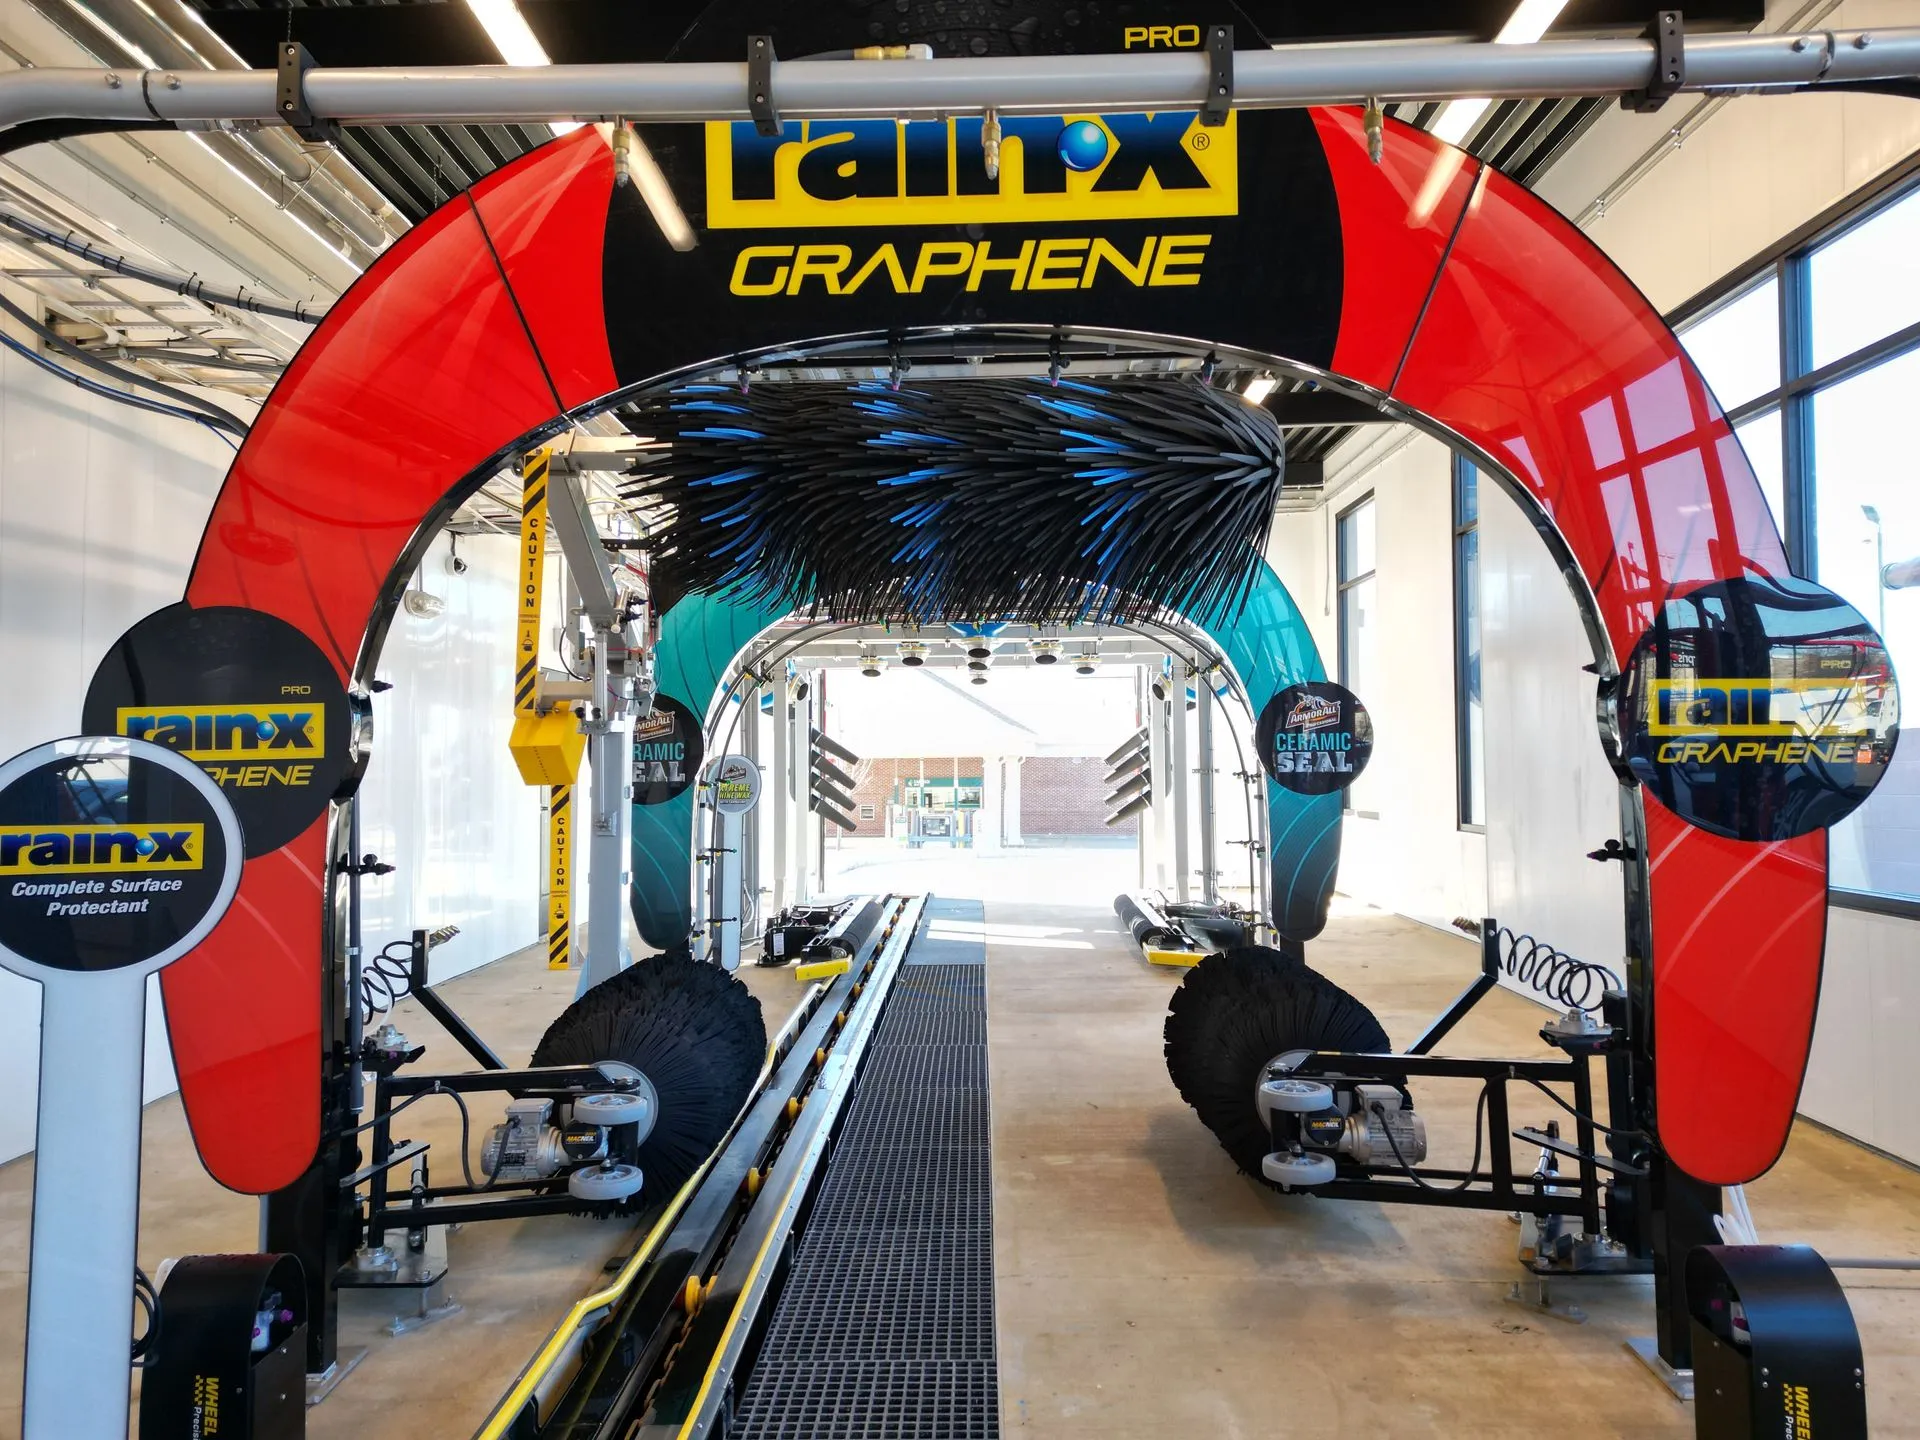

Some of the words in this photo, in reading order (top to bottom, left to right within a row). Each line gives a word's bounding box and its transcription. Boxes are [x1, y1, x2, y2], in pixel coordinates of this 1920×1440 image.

[1123, 24, 1201, 49] PRO
[729, 233, 1213, 296] GRAPHENE
[525, 517, 539, 608] CAUTION
[1820, 659, 1852, 669] PRO
[281, 685, 311, 695] PRO
[633, 742, 685, 761] RAMIC
[1276, 732, 1352, 751] CERAMIC
[1277, 751, 1353, 773] SEAL
[1656, 742, 1857, 764] GRAPHENE
[203, 765, 314, 787] PHENE
[632, 762, 686, 783] EAL
[555, 817, 566, 886] CAUTION
[12, 879, 105, 898] Complete
[110, 878, 183, 893] Surface
[46, 898, 150, 917] Protectant
[204, 1377, 219, 1436] WHEEL
